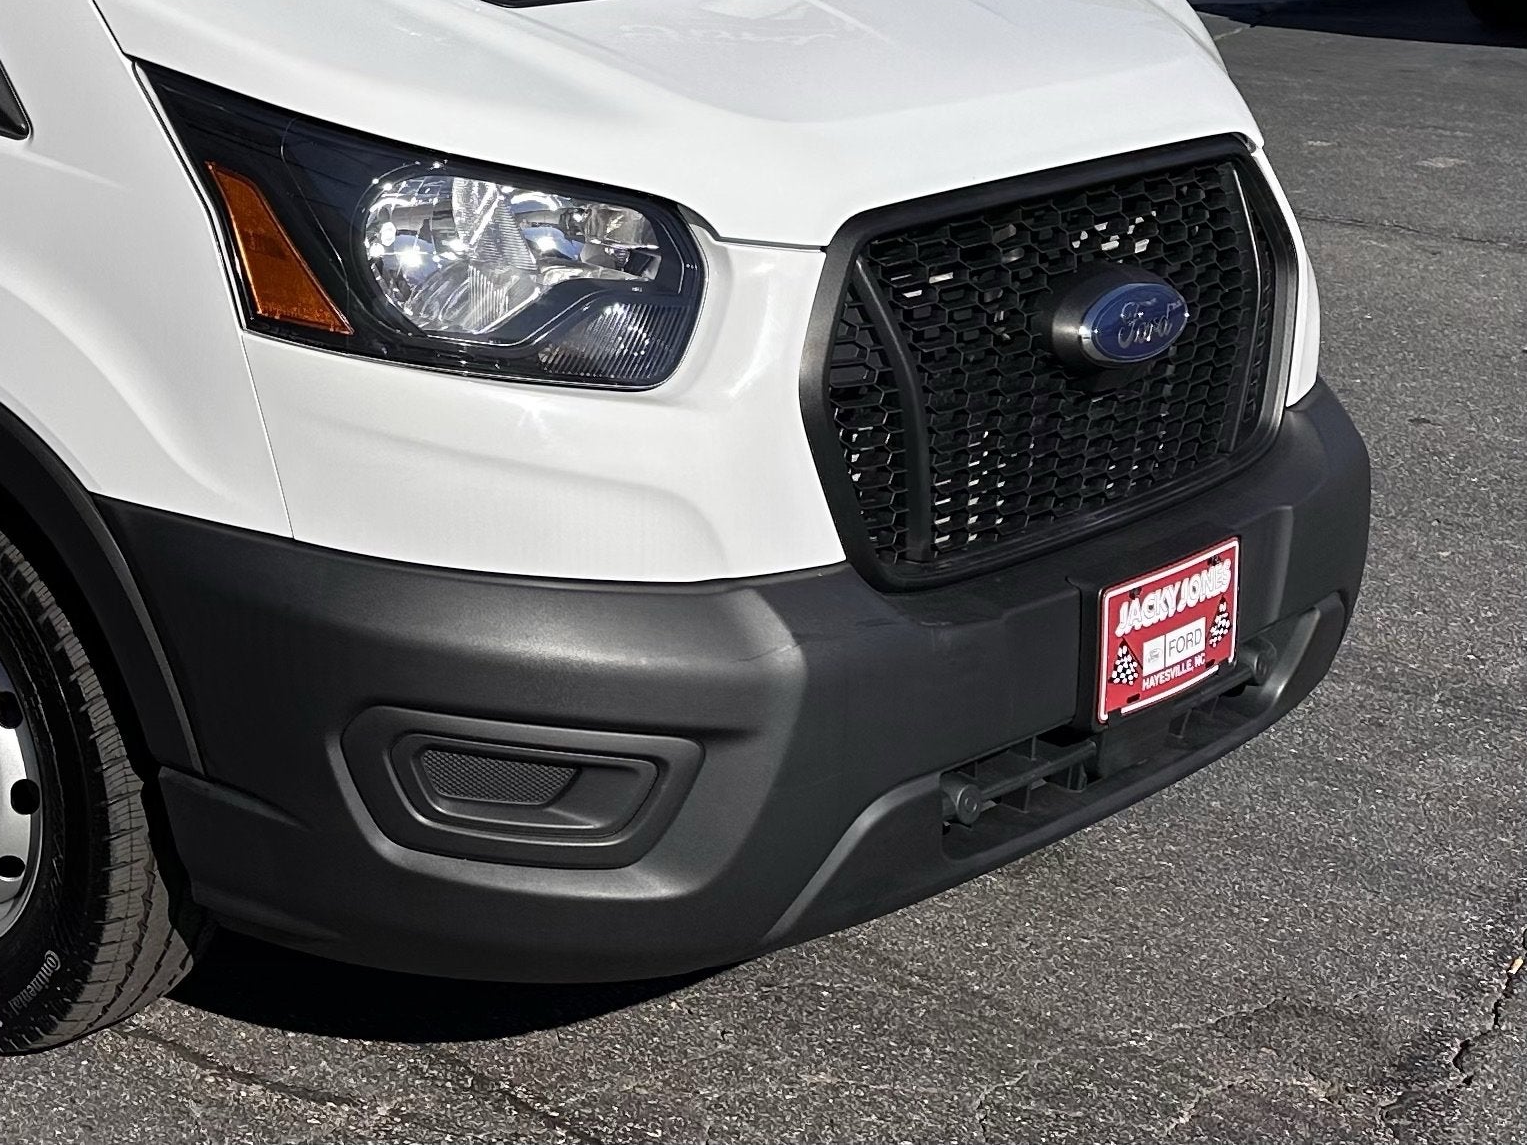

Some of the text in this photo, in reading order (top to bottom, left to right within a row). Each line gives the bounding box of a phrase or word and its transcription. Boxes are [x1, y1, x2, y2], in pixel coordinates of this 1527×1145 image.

[1117, 297, 1181, 349] Ford
[1115, 558, 1232, 637] JACKY JONES
[1168, 627, 1203, 657] FORD
[1194, 652, 1206, 667] NC
[8, 949, 61, 1015] Continental
